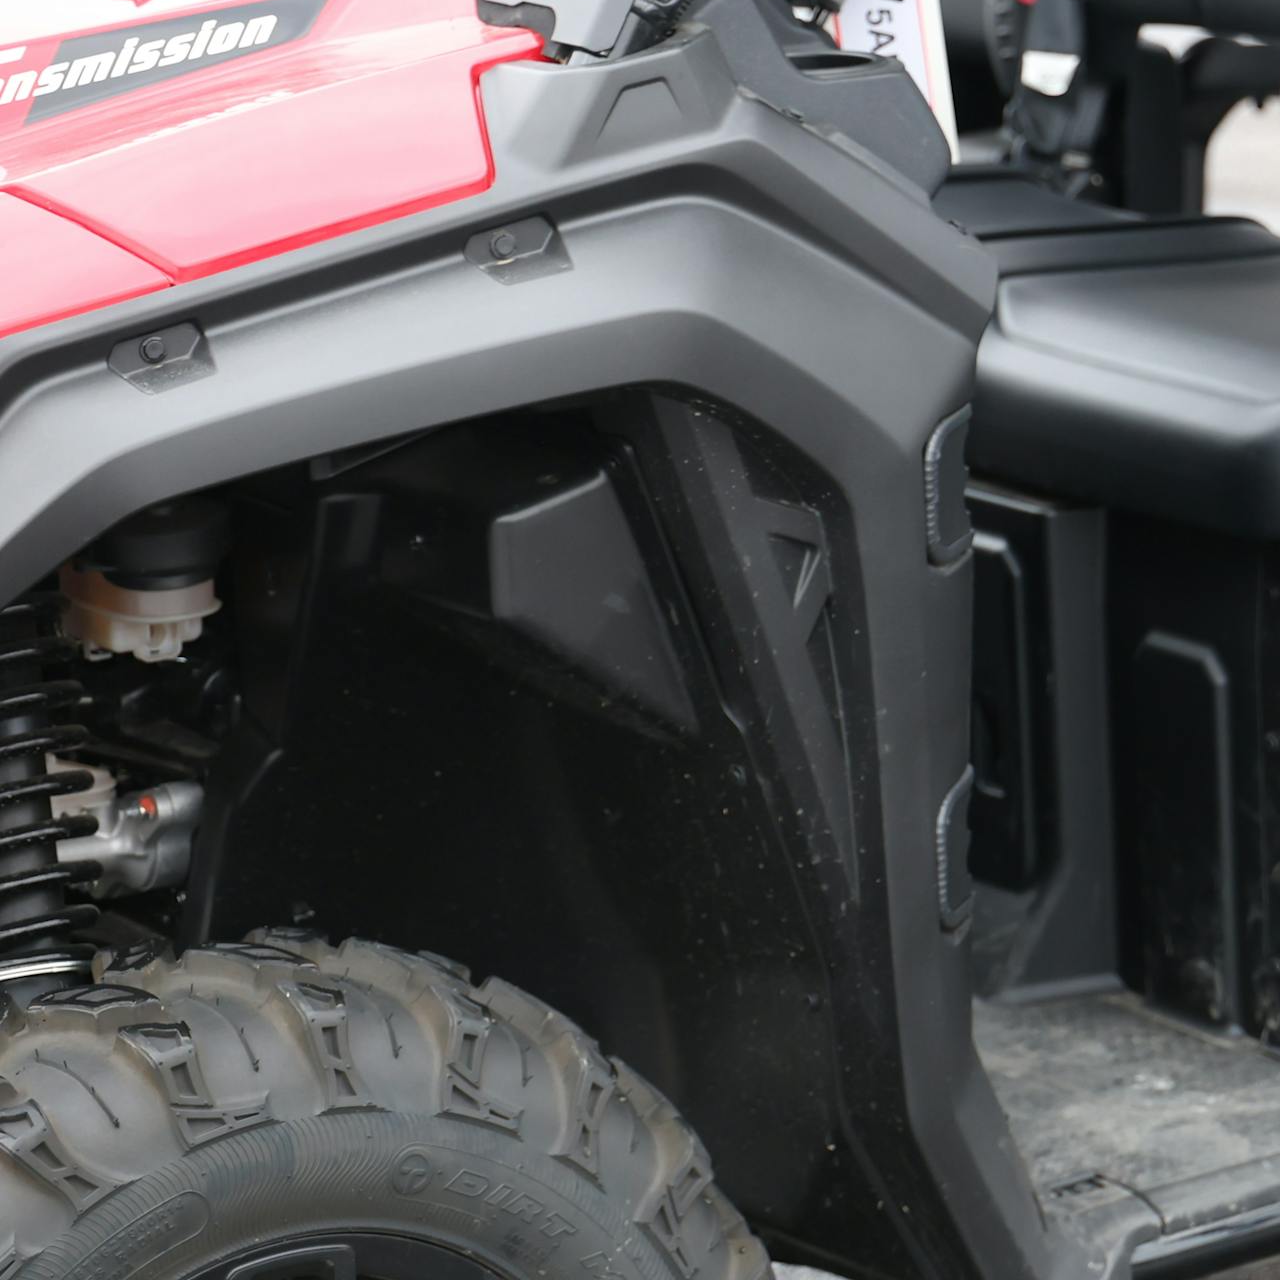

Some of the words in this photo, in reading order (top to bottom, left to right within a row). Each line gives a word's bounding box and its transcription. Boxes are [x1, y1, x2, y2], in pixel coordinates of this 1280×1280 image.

[0, 14, 278, 106] nsmission
[865, 9, 897, 58] 5A
[444, 1168, 577, 1239] DIRT
